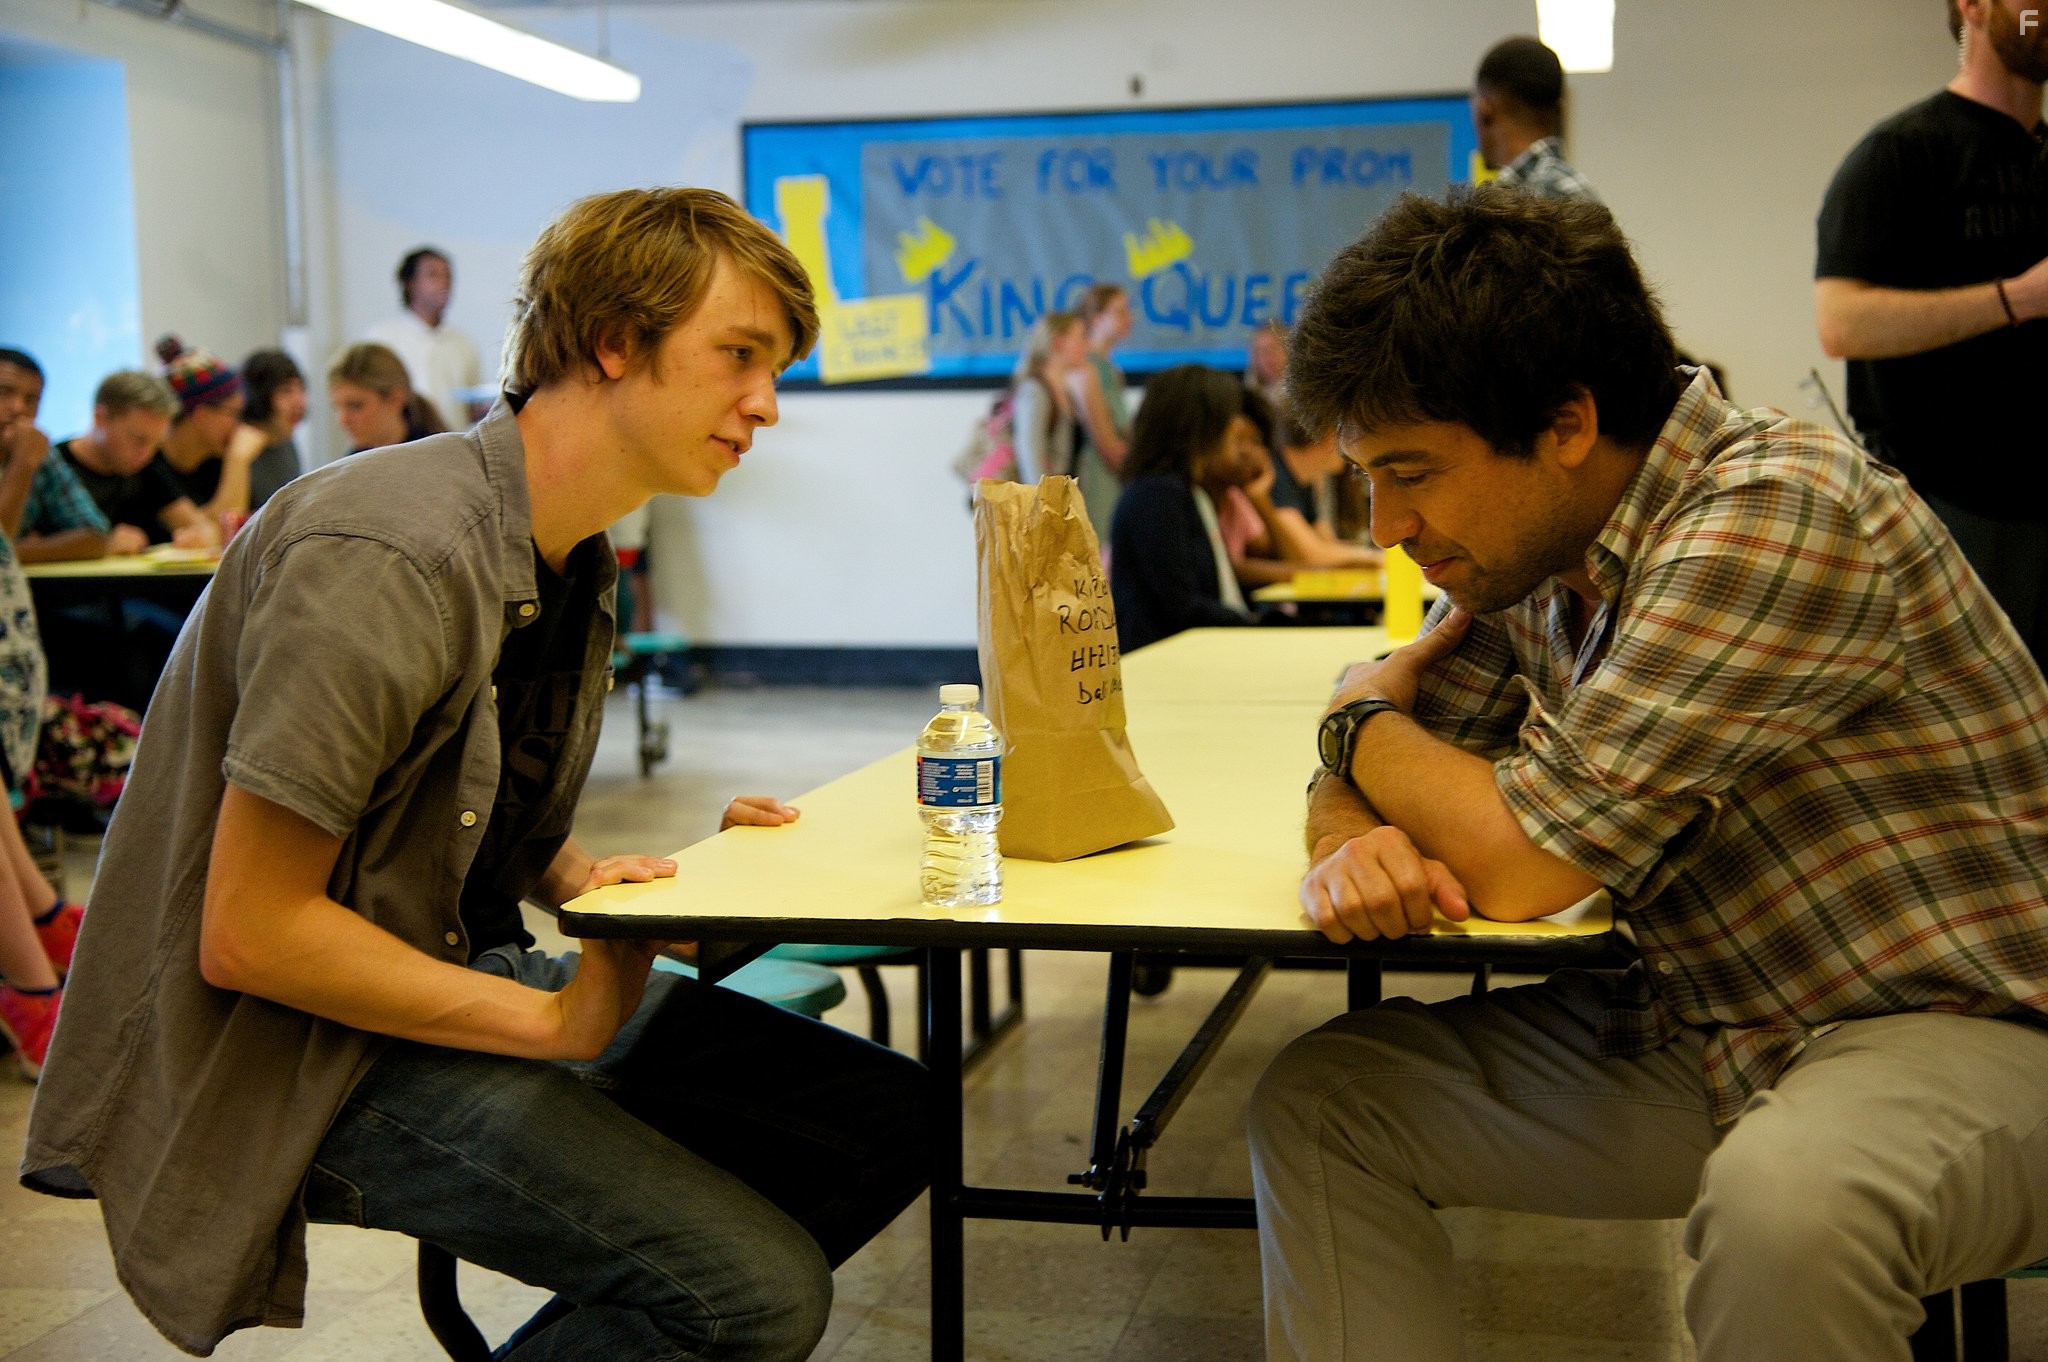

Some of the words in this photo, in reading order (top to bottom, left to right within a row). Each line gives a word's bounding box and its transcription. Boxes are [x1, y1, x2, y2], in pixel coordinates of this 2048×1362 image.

[893, 155, 1006, 198] VOTE
[1037, 147, 1118, 192] FOR
[1150, 148, 1260, 191] YOUR
[1291, 145, 1412, 188] PROM
[1140, 261, 1310, 331] QUEE
